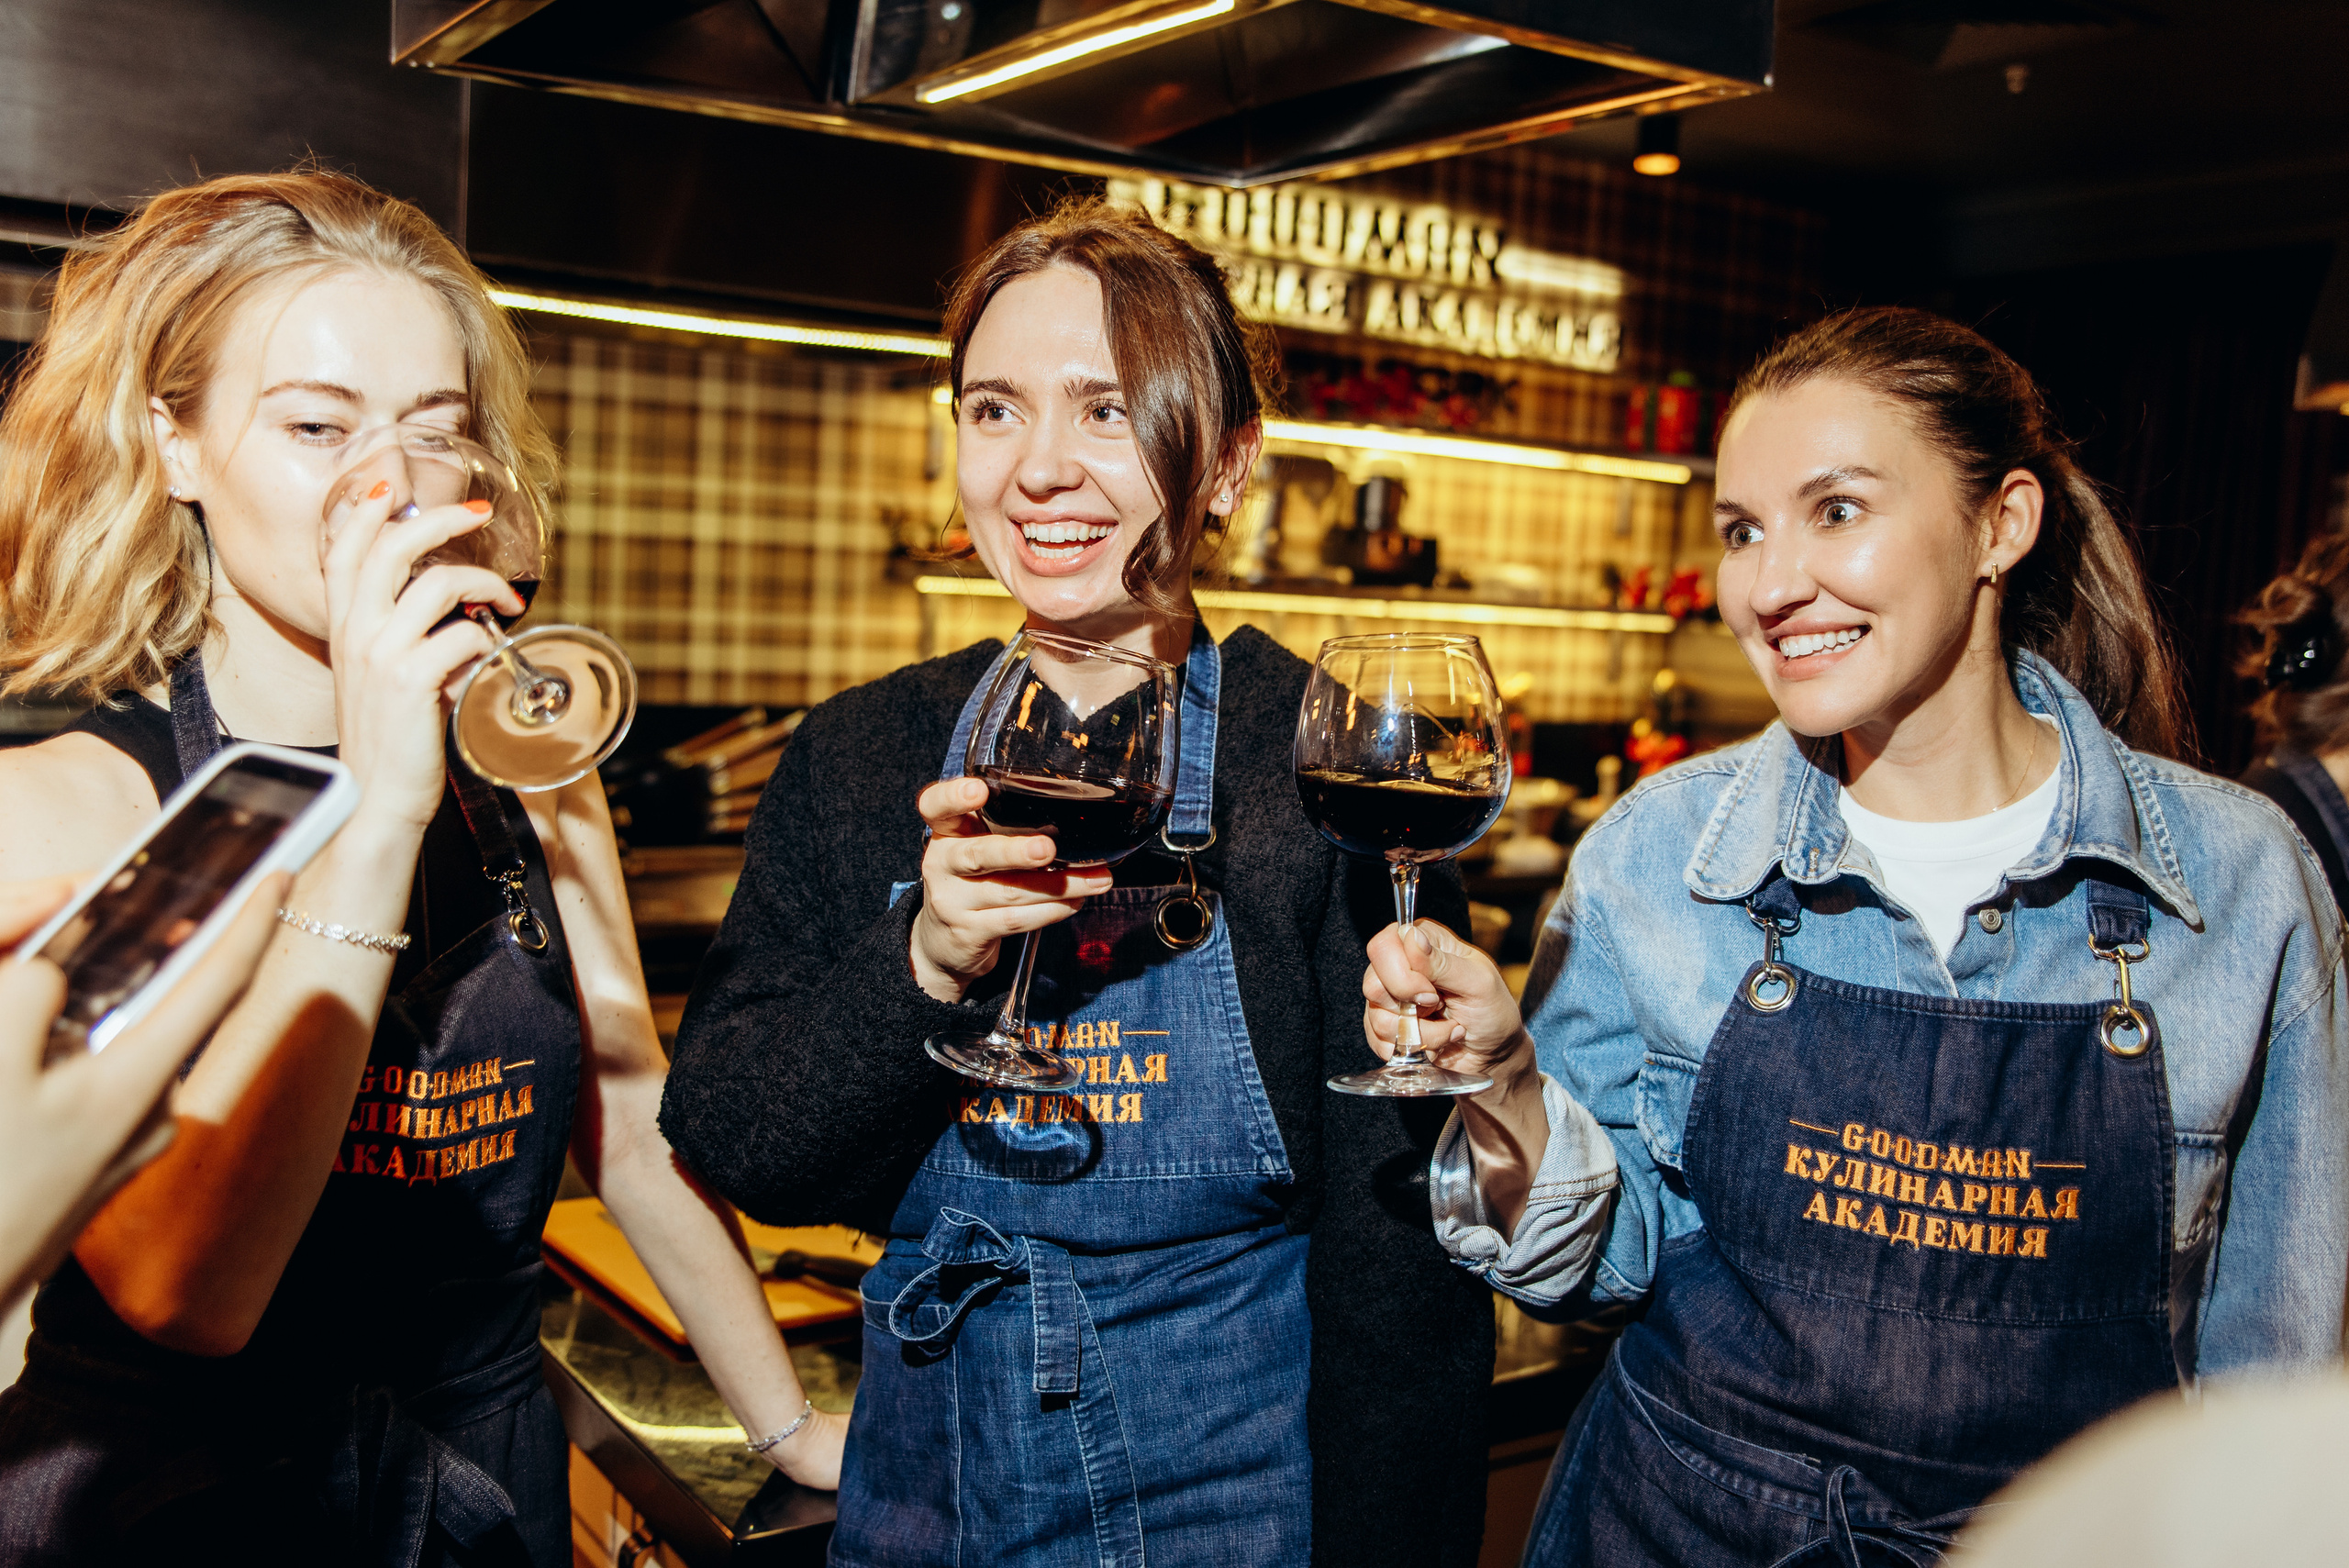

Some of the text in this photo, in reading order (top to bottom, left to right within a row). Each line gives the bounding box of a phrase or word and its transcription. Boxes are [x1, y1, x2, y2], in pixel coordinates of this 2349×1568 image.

[1025, 1020, 1120, 1049] DMAN
[359, 1057, 503, 1100] GOODMAN
[350, 1084, 535, 1140] ЛИНАРНАЯ
[1842, 1122, 2032, 1179] GOODMAN
[1784, 1144, 2080, 1220] КУЛИНАРНАЯ
[1803, 1192, 2050, 1259] АКАДЕМИЯ
